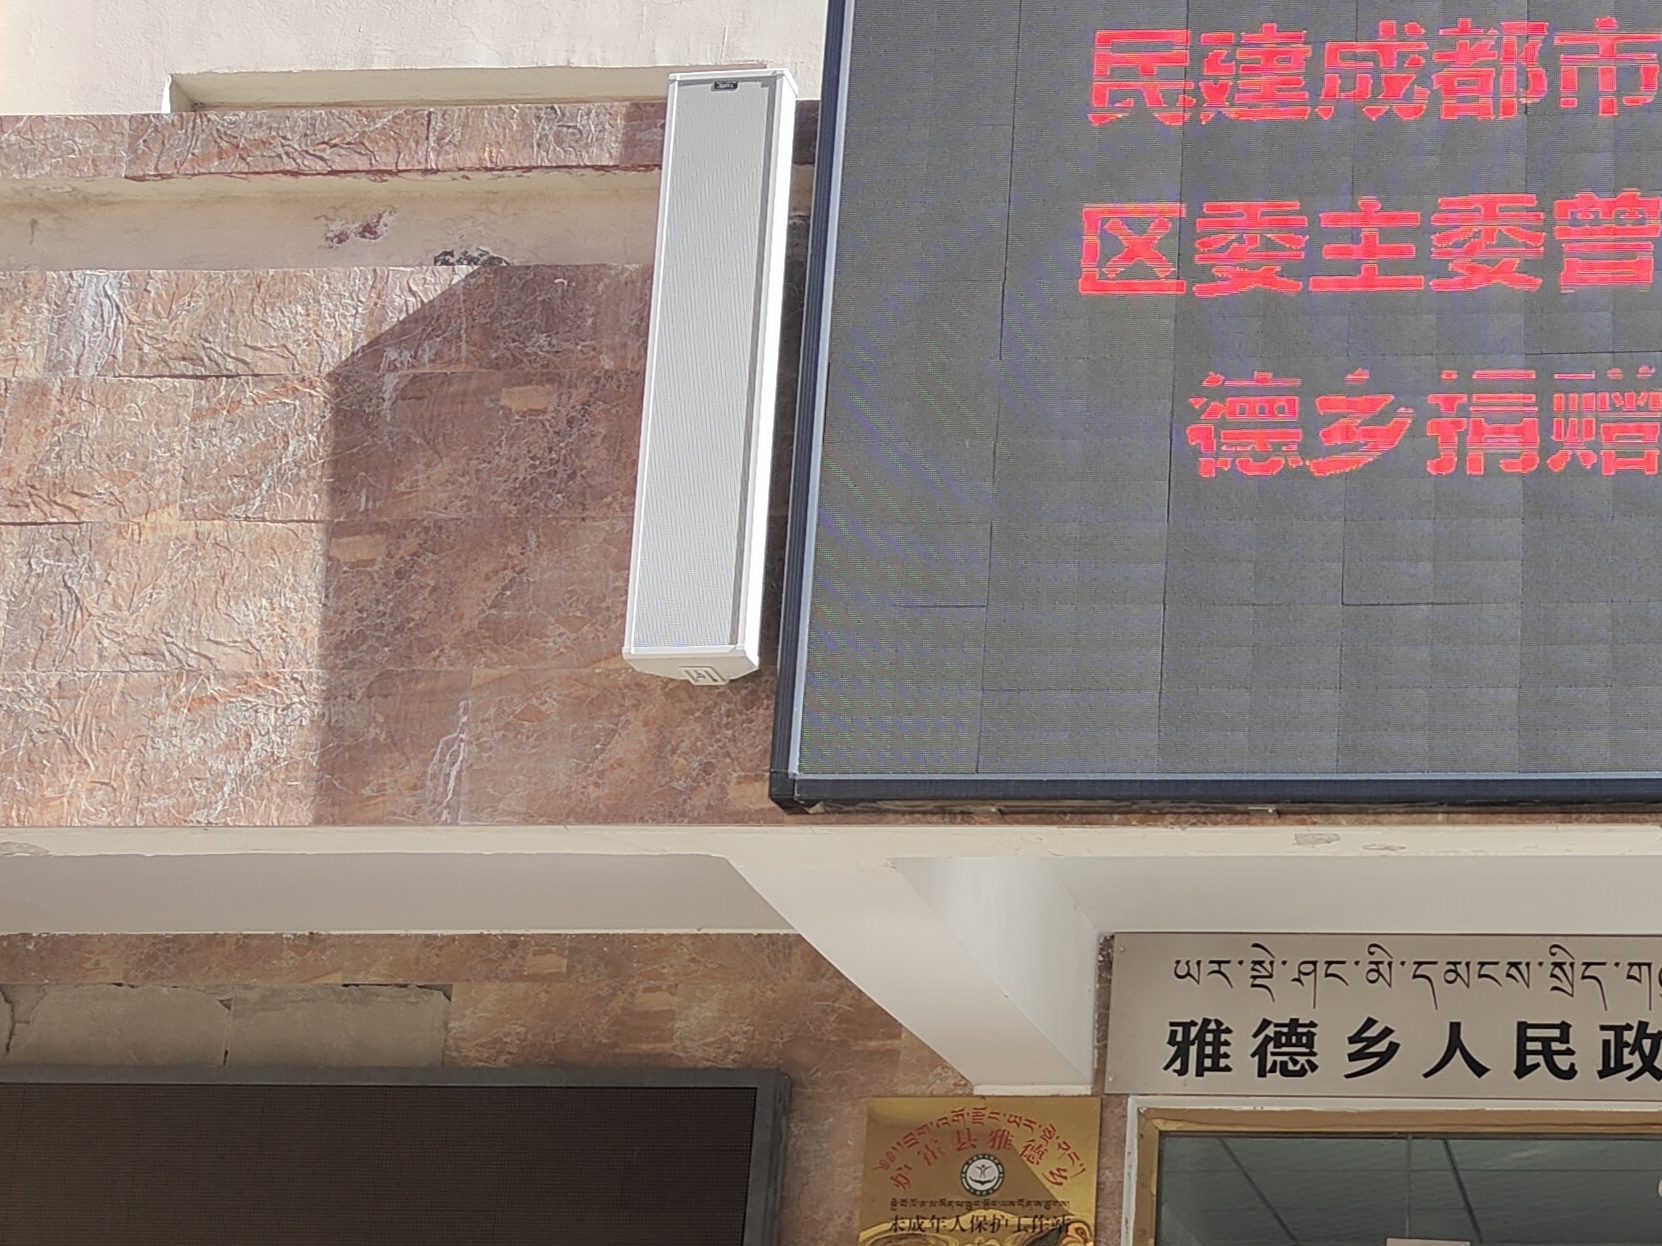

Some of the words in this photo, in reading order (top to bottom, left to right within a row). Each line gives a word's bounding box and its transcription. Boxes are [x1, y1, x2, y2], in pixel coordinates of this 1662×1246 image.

[890, 1213, 1072, 1233] 未成年人保护工作站
